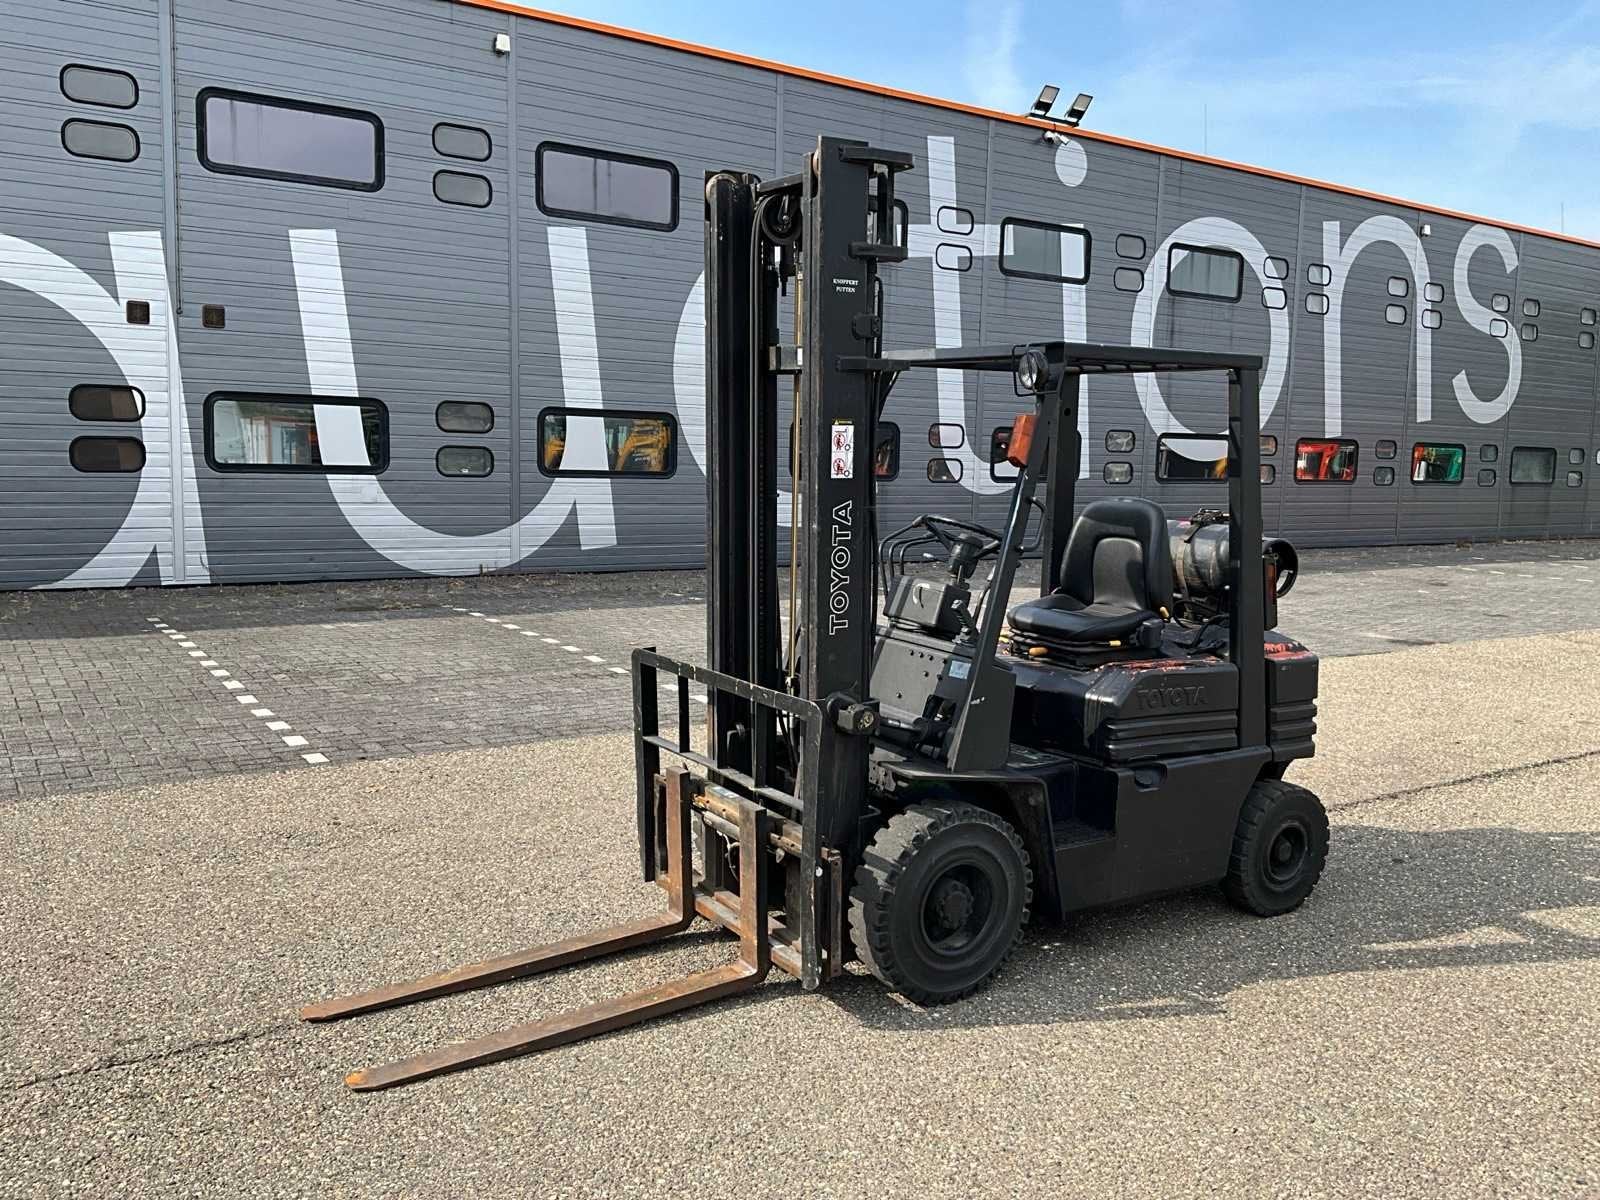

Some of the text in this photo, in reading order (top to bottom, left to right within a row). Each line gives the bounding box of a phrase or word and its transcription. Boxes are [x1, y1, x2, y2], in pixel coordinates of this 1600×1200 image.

[0, 136, 1523, 590] autions
[829, 500, 852, 635] TOYOTA
[1137, 686, 1208, 710] TOYOTA
